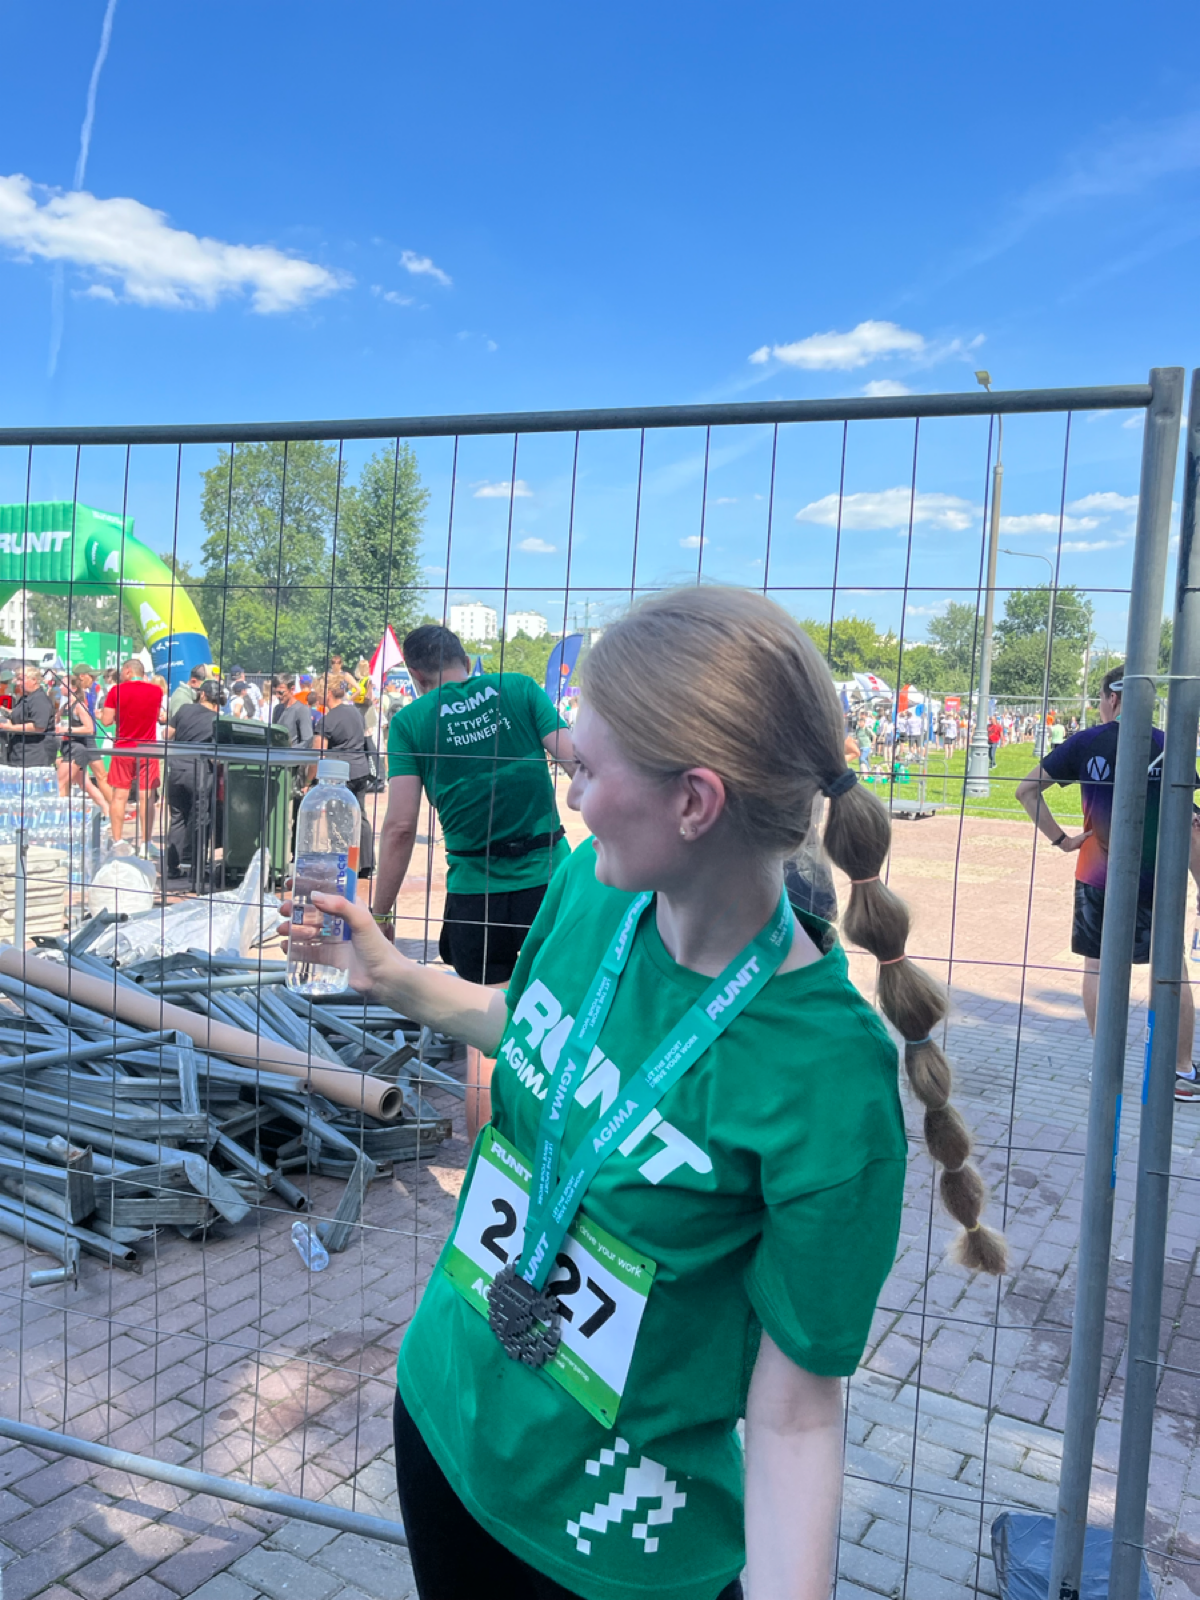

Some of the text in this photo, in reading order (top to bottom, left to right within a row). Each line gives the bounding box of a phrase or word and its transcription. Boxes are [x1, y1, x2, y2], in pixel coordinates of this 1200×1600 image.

[440, 685, 500, 717] AGIMA
[705, 955, 761, 1021] RUNIT
[645, 1040, 682, 1084] LET THE SPORT
[649, 1033, 700, 1089] DRIVE YOUR WORK
[549, 1058, 577, 1121] AGIMA
[593, 1099, 640, 1153] AGIMA
[491, 1141, 533, 1182] RUNIT
[480, 1198, 616, 1339] 227
[597, 1242, 617, 1261] your
[618, 1257, 643, 1278] work
